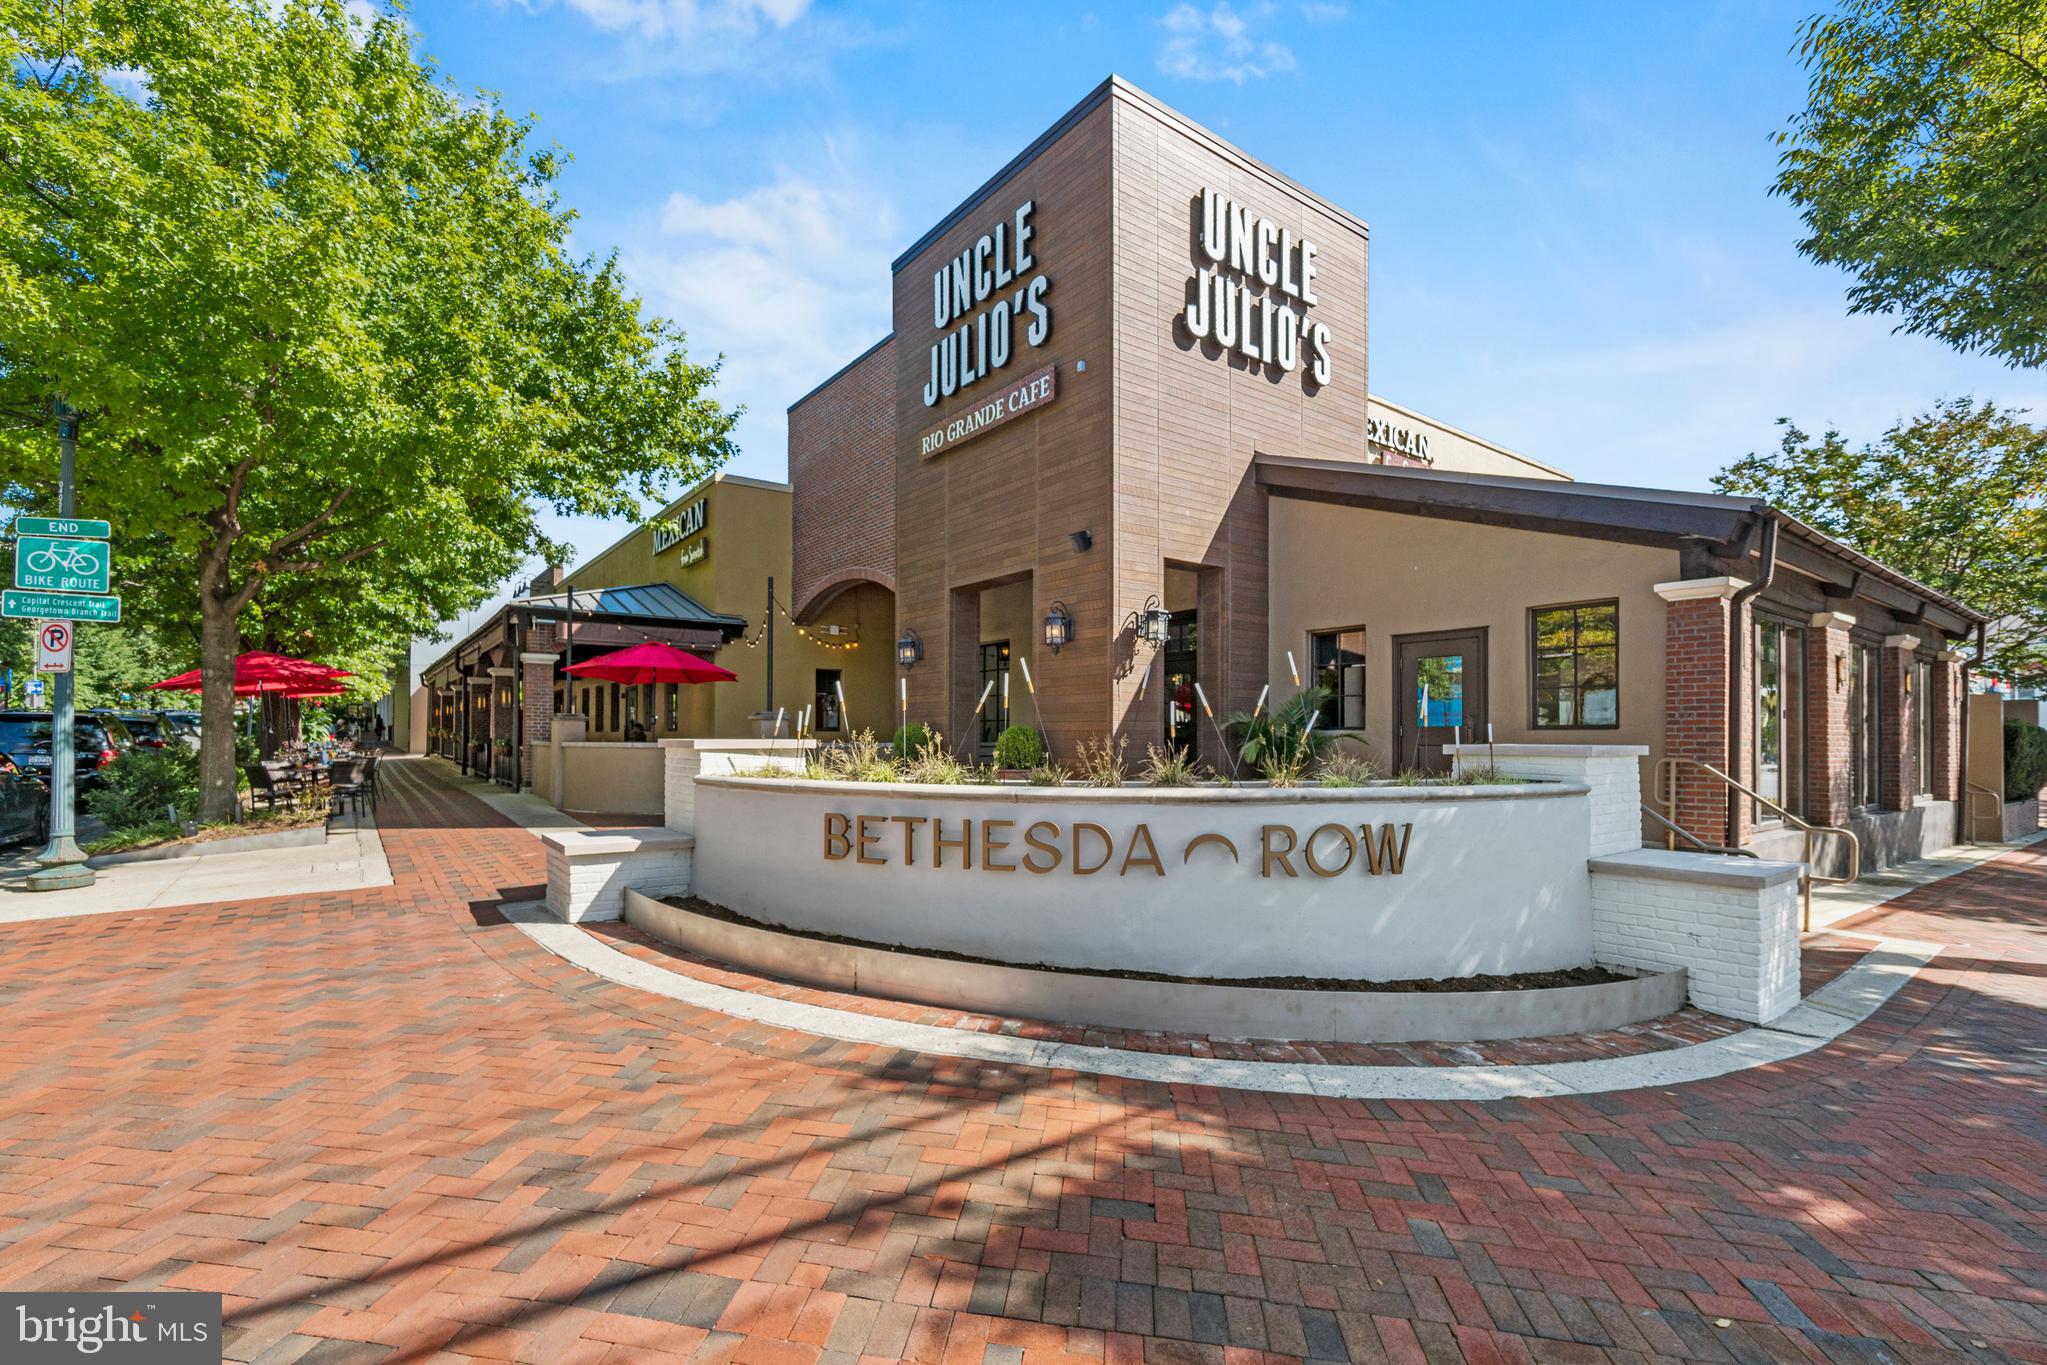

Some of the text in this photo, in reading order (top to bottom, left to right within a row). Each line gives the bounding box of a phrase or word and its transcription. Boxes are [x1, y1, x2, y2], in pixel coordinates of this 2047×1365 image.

[934, 200, 1034, 329] UNCLE
[1200, 186, 1318, 307] UNCLE
[924, 275, 1049, 407] JULIO'S
[1187, 266, 1331, 387] JULIO'S
[921, 375, 1050, 454] RIO GRANDE CAFE
[1368, 416, 1431, 460] EXICAN
[49, 522, 79, 534] END
[21, 605, 117, 618] Georgetown Branch Trail
[22, 596, 49, 605] Capital
[52, 599, 86, 607] Crescent
[25, 575, 100, 589] BIKE ROUTE
[824, 812, 1413, 878] BETHESDA ROW
